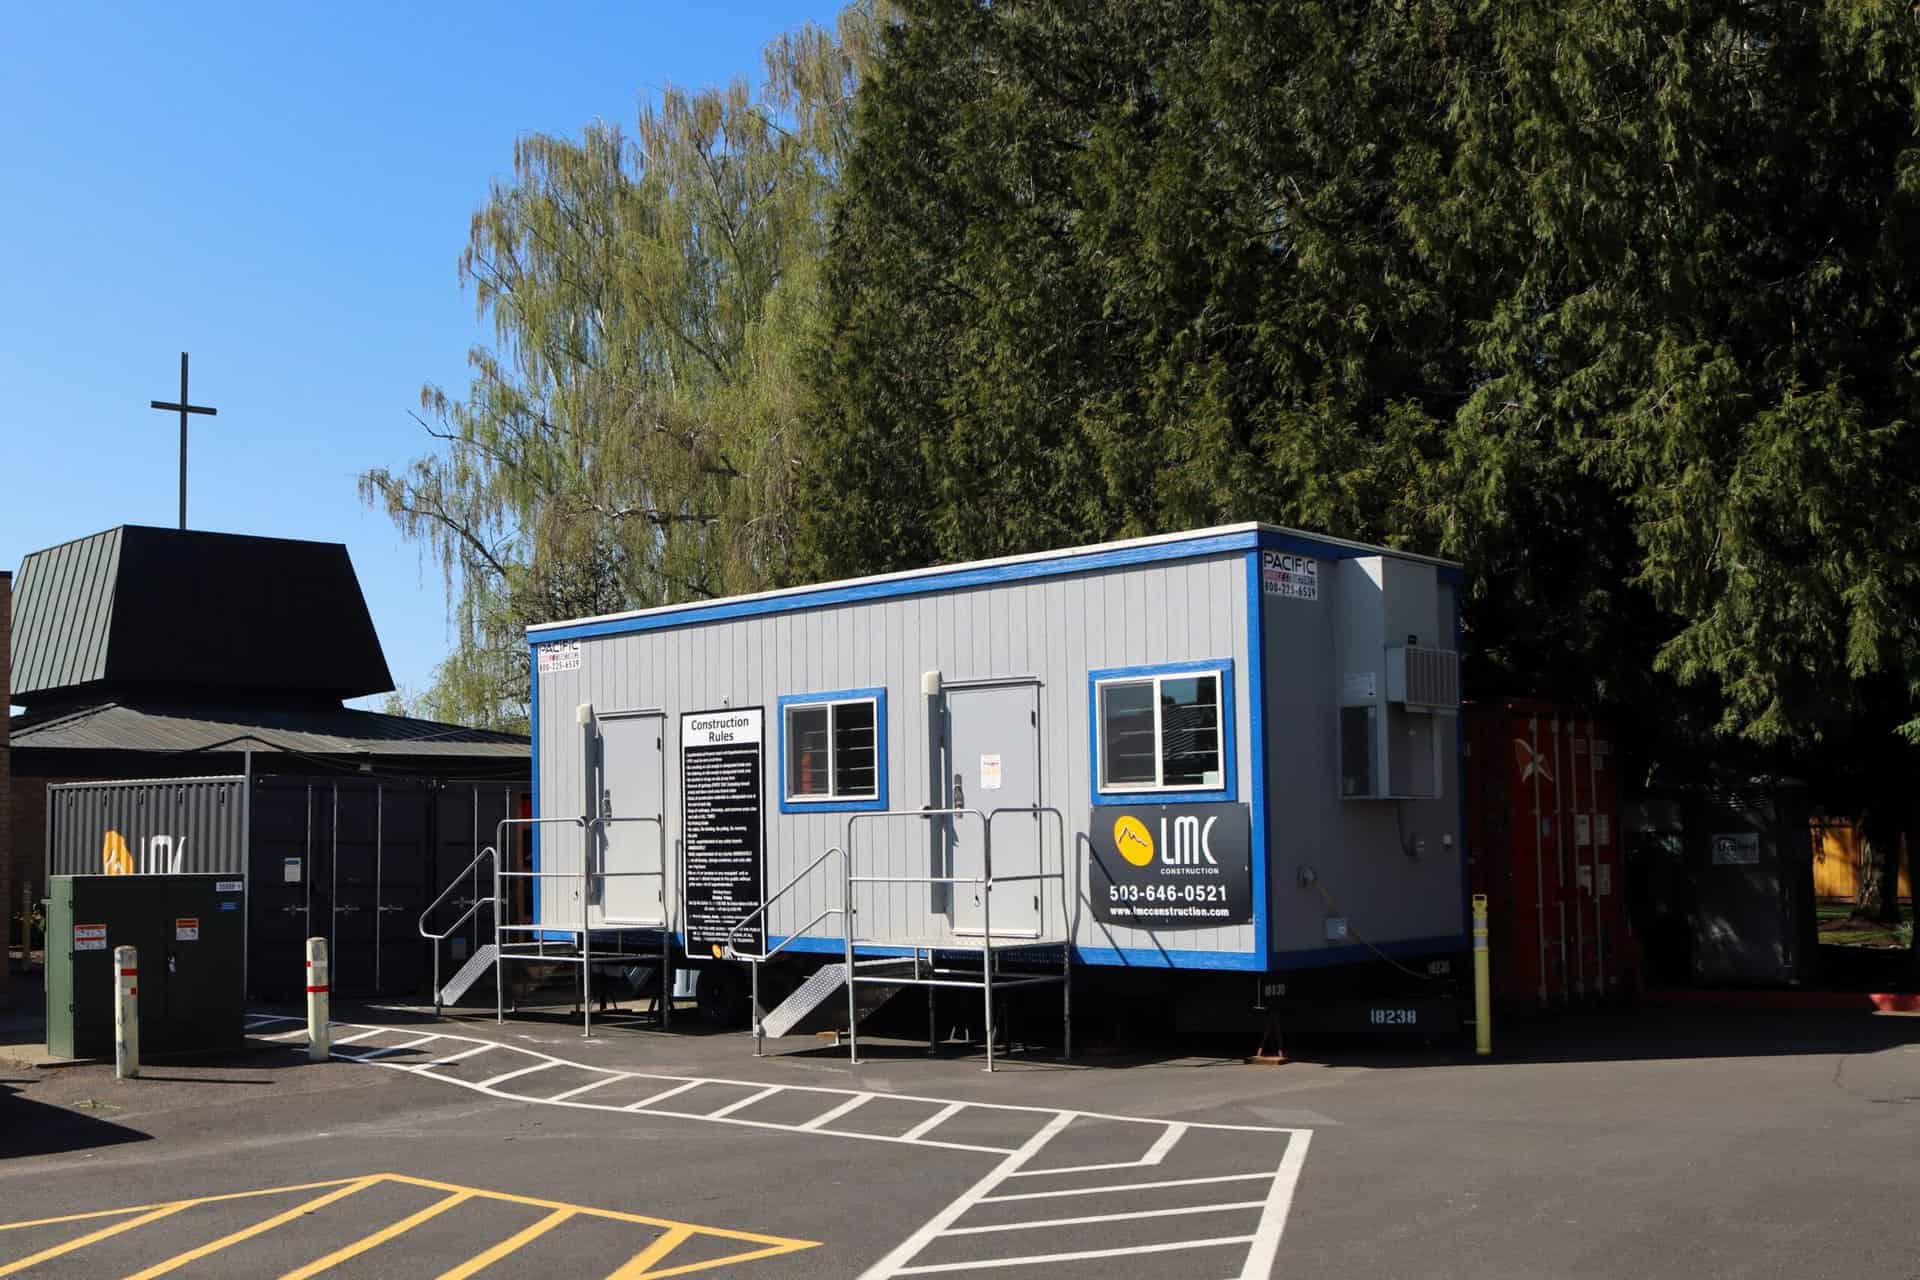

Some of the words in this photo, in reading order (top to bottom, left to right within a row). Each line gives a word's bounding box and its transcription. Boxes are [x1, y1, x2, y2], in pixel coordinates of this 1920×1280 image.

[1264, 552, 1315, 575] PACIFIC
[539, 640, 579, 653] PACIFIC
[691, 718, 750, 730] Construction
[708, 731, 735, 742] Rules
[1161, 816, 1218, 865] LMC
[1109, 885, 1227, 901] 503-646-0521
[1110, 906, 1229, 917] www.lmcconstruction.com
[1370, 1008, 1417, 1025] 18238
